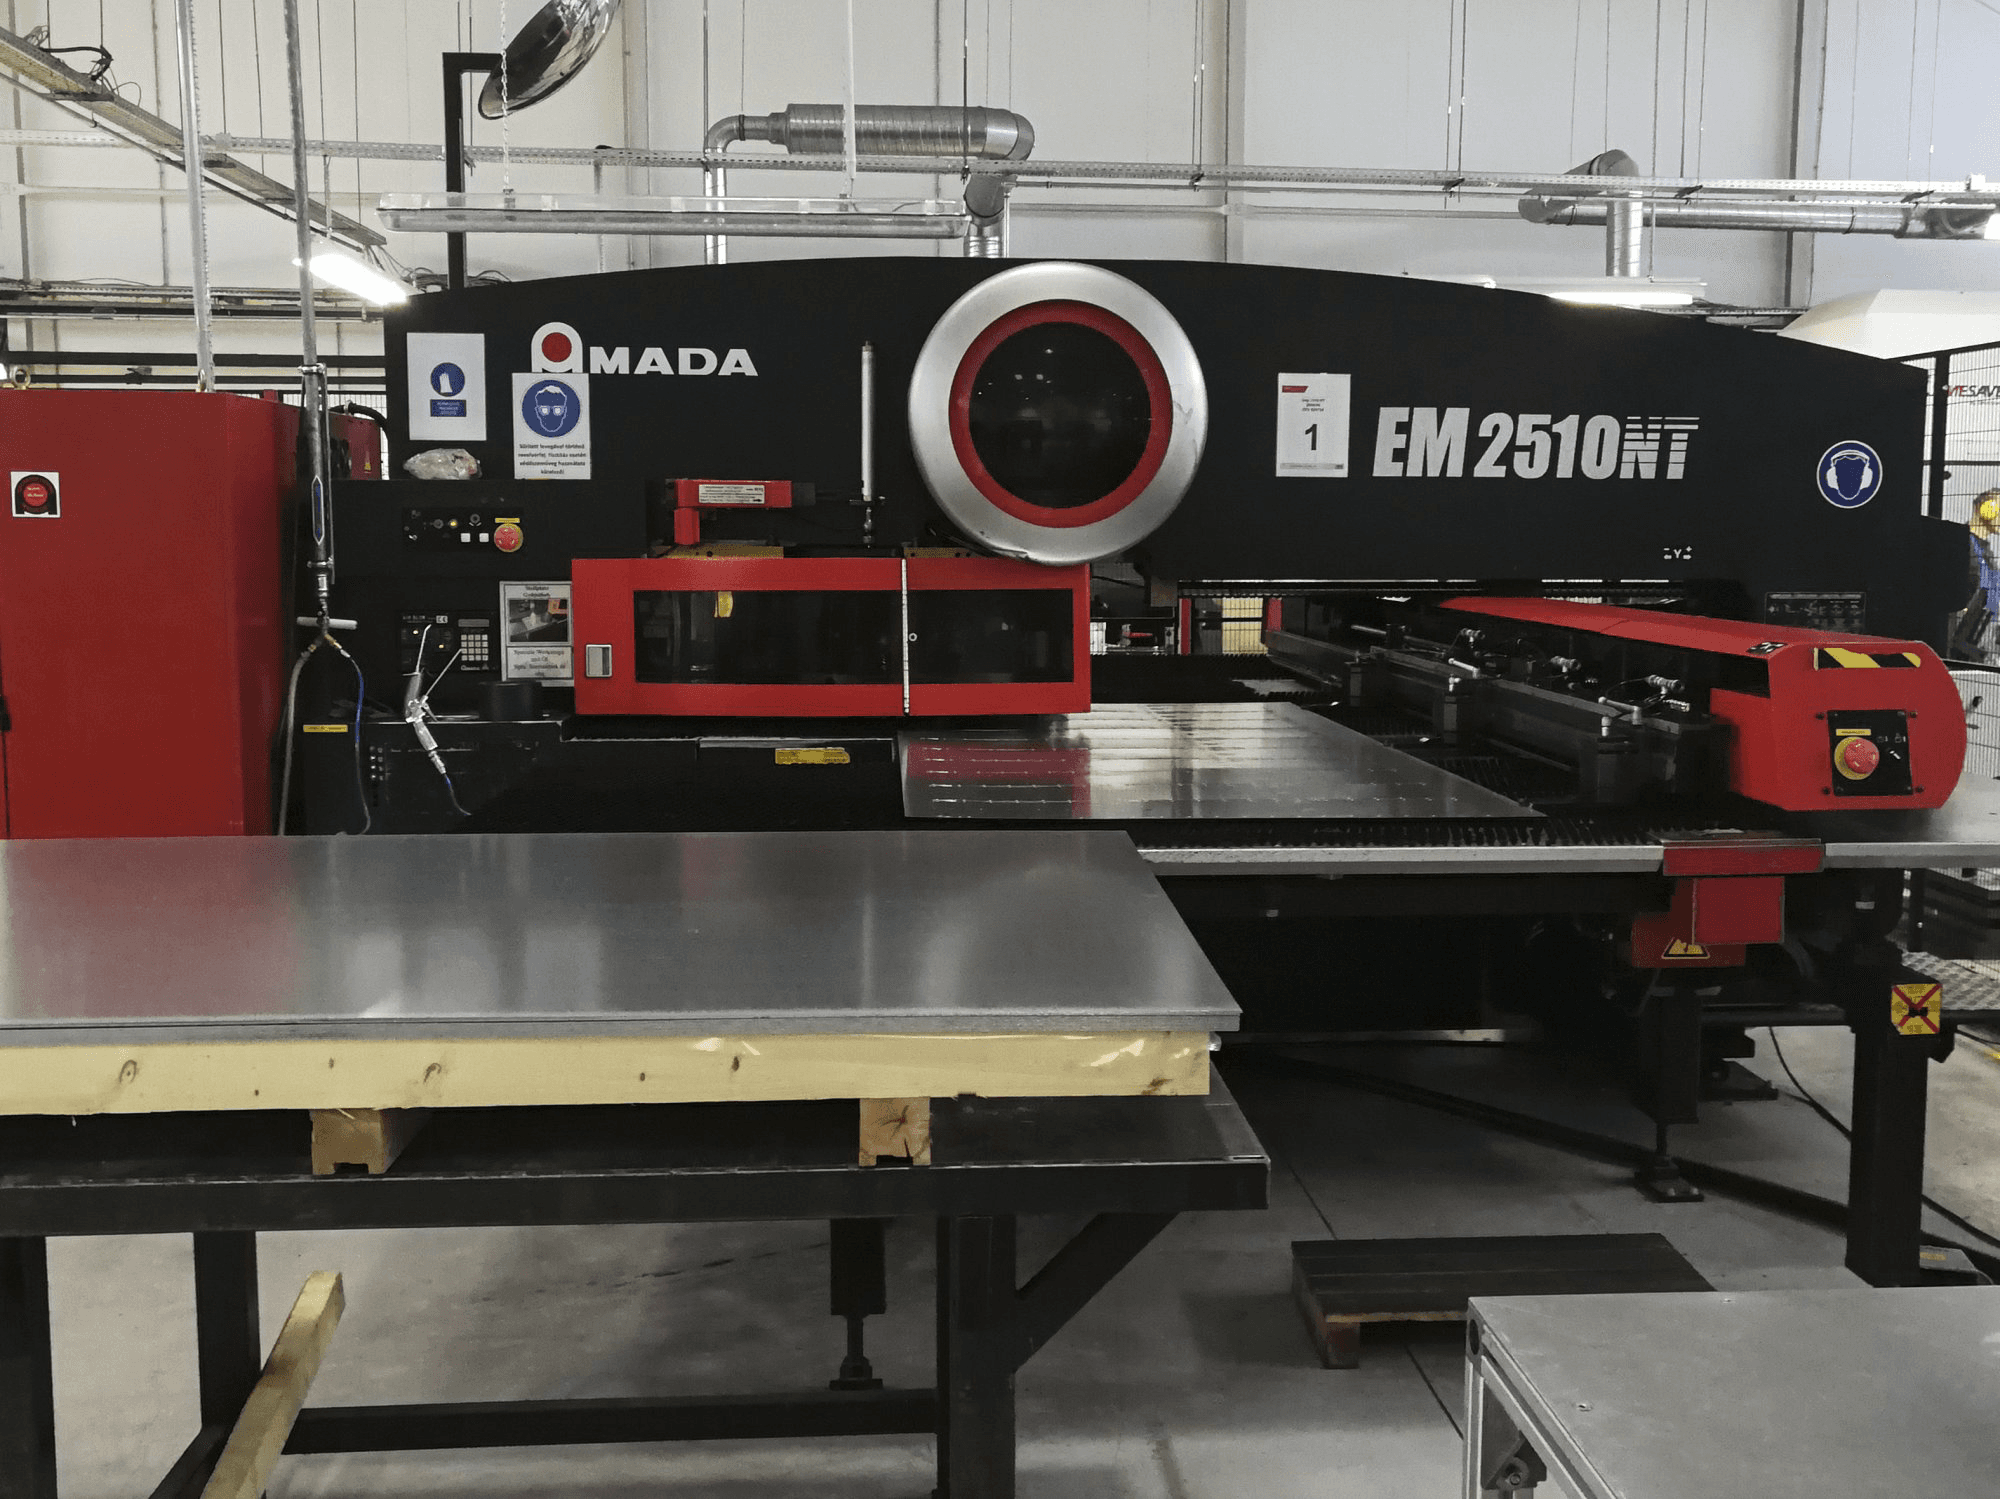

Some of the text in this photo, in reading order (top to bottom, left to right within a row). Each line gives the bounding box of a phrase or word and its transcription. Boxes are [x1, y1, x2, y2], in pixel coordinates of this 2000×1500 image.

[531, 321, 759, 377] AMADA
[1305, 423, 1318, 451] 1
[1372, 406, 1470, 477] EM
[1673, 548, 1682, 559] Y
